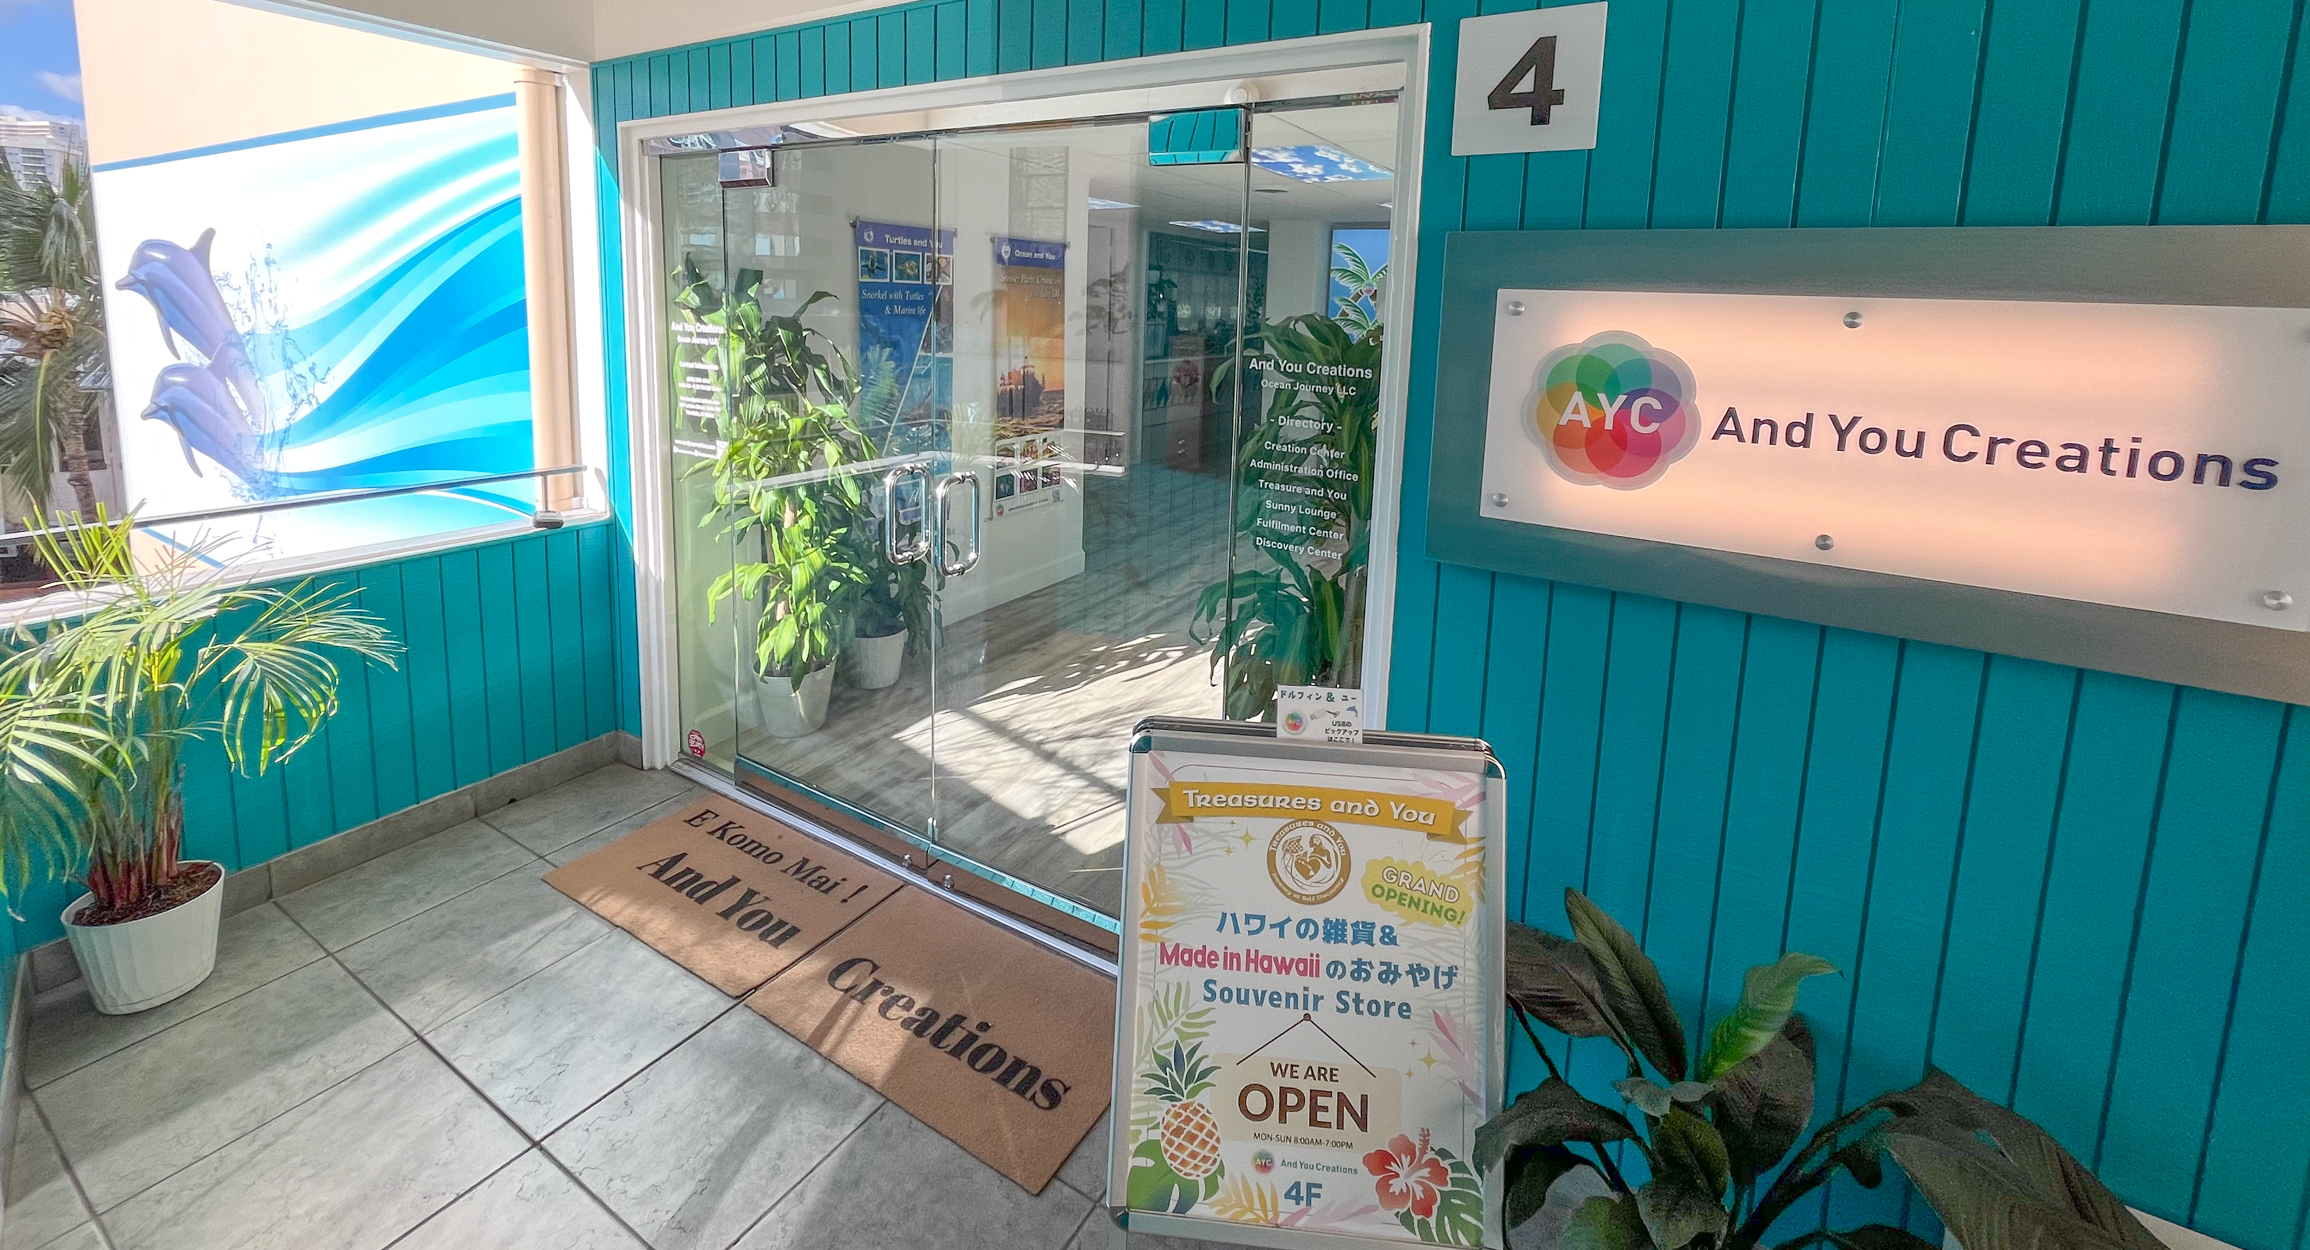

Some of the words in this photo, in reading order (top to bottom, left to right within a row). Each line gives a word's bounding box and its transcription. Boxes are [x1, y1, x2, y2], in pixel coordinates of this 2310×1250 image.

[1488, 36, 1564, 126] 4
[885, 234, 912, 246] Turtles
[913, 239, 928, 247] and
[1014, 250, 1032, 258] Ocean
[1046, 252, 1056, 260] You
[862, 289, 887, 300] Snorkel
[888, 291, 903, 300] with
[905, 291, 924, 301] Turtles
[884, 305, 892, 314] &
[893, 305, 916, 315] Marine
[917, 305, 926, 316] life
[671, 321, 683, 331] And
[1250, 358, 1274, 371] And
[1278, 360, 1302, 374] You
[1306, 362, 1373, 379] Creations
[1261, 379, 1291, 390] Ocean
[1293, 382, 1334, 395] Journey
[1336, 384, 1356, 396] LLC
[1278, 416, 1334, 433] Directory
[1264, 441, 1307, 454] Creation
[1310, 446, 1345, 460] Center
[1558, 392, 1662, 434] AYC
[1712, 407, 1814, 448] And
[1828, 414, 1926, 458] You
[1942, 423, 2280, 490] Creations
[1250, 459, 1324, 476] Administration
[1326, 468, 1358, 482] Office
[1258, 479, 1302, 494] Treasure
[1304, 486, 1324, 497] and
[1326, 488, 1347, 500] You
[1265, 500, 1296, 514] Sunny
[1298, 504, 1337, 520] Lounge
[1256, 518, 1306, 534] Fulfilment
[1308, 526, 1344, 540] Center
[1256, 536, 1305, 555] Discovery
[1307, 546, 1342, 560] Center
[1280, 690, 1322, 700] ドルフィン
[1326, 692, 1335, 702] &
[1182, 789, 1322, 811] Treasures
[1330, 798, 1380, 817] and
[1389, 802, 1436, 826] You
[684, 808, 720, 828] E
[706, 820, 784, 865] Komo
[1269, 820, 1314, 852] Treasures
[1316, 823, 1336, 836] and
[1336, 836, 1346, 856] You
[1382, 866, 1460, 904] GRAND
[636, 852, 742, 906] And
[715, 887, 802, 950] You
[1371, 884, 1466, 926] OPENING!
[1160, 941, 1220, 968] Made
[1223, 946, 1242, 971] in
[1245, 948, 1320, 978] Hawaii
[1326, 958, 1458, 991] のおみやげ
[1203, 978, 1324, 1012] Souvenir
[1336, 990, 1412, 1020] Store
[827, 957, 1072, 1111] Creations
[1270, 1062, 1300, 1079] WE
[1304, 1066, 1339, 1083] ARE
[1238, 1083, 1368, 1133] OPEN
[1254, 1132, 1292, 1144] MON-SUN
[1294, 1136, 1354, 1150] 8:00AM-7:00PM
[1256, 1158, 1272, 1167] AYC
[1280, 1159, 1298, 1169] And
[1299, 1160, 1314, 1170] You
[1316, 1163, 1358, 1175] Creations
[1284, 1180, 1322, 1207] 4F
